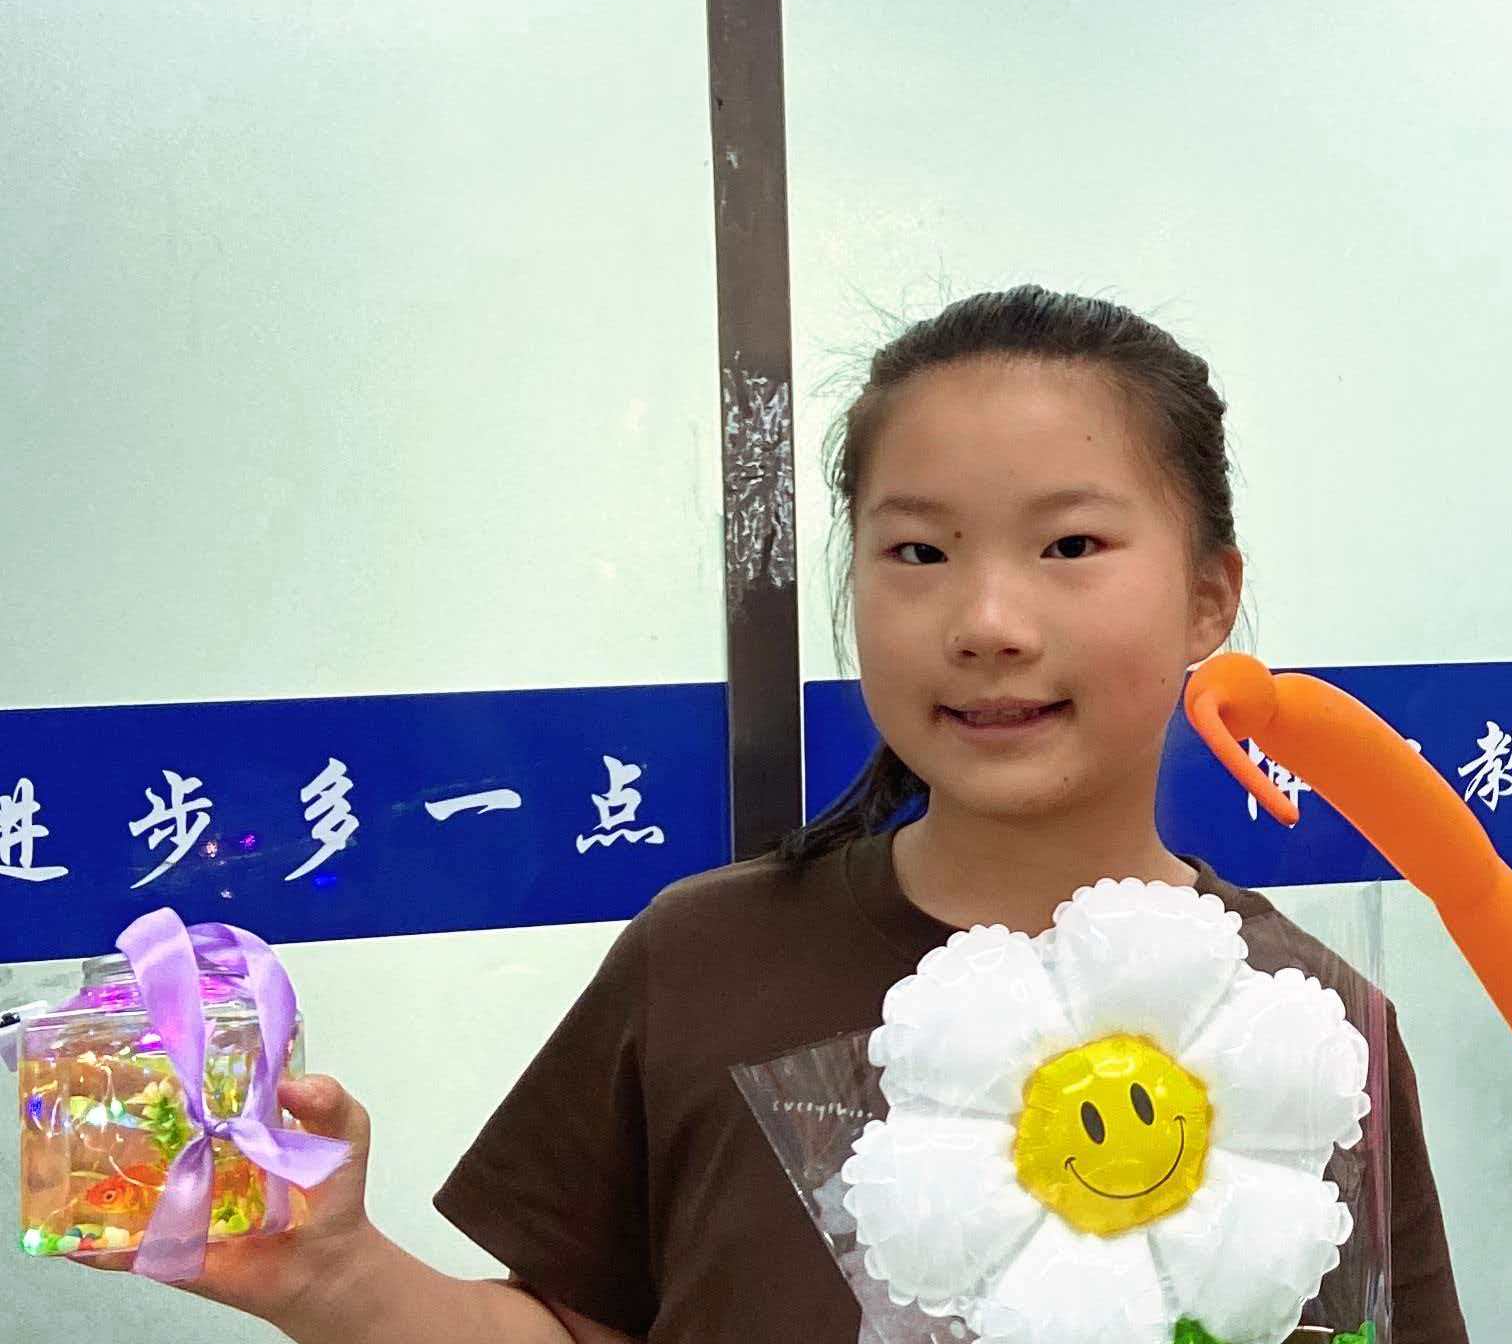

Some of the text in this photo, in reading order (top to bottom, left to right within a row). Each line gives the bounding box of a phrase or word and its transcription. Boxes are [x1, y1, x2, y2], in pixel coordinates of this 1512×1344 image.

[0, 755, 665, 889] 进步多一点
